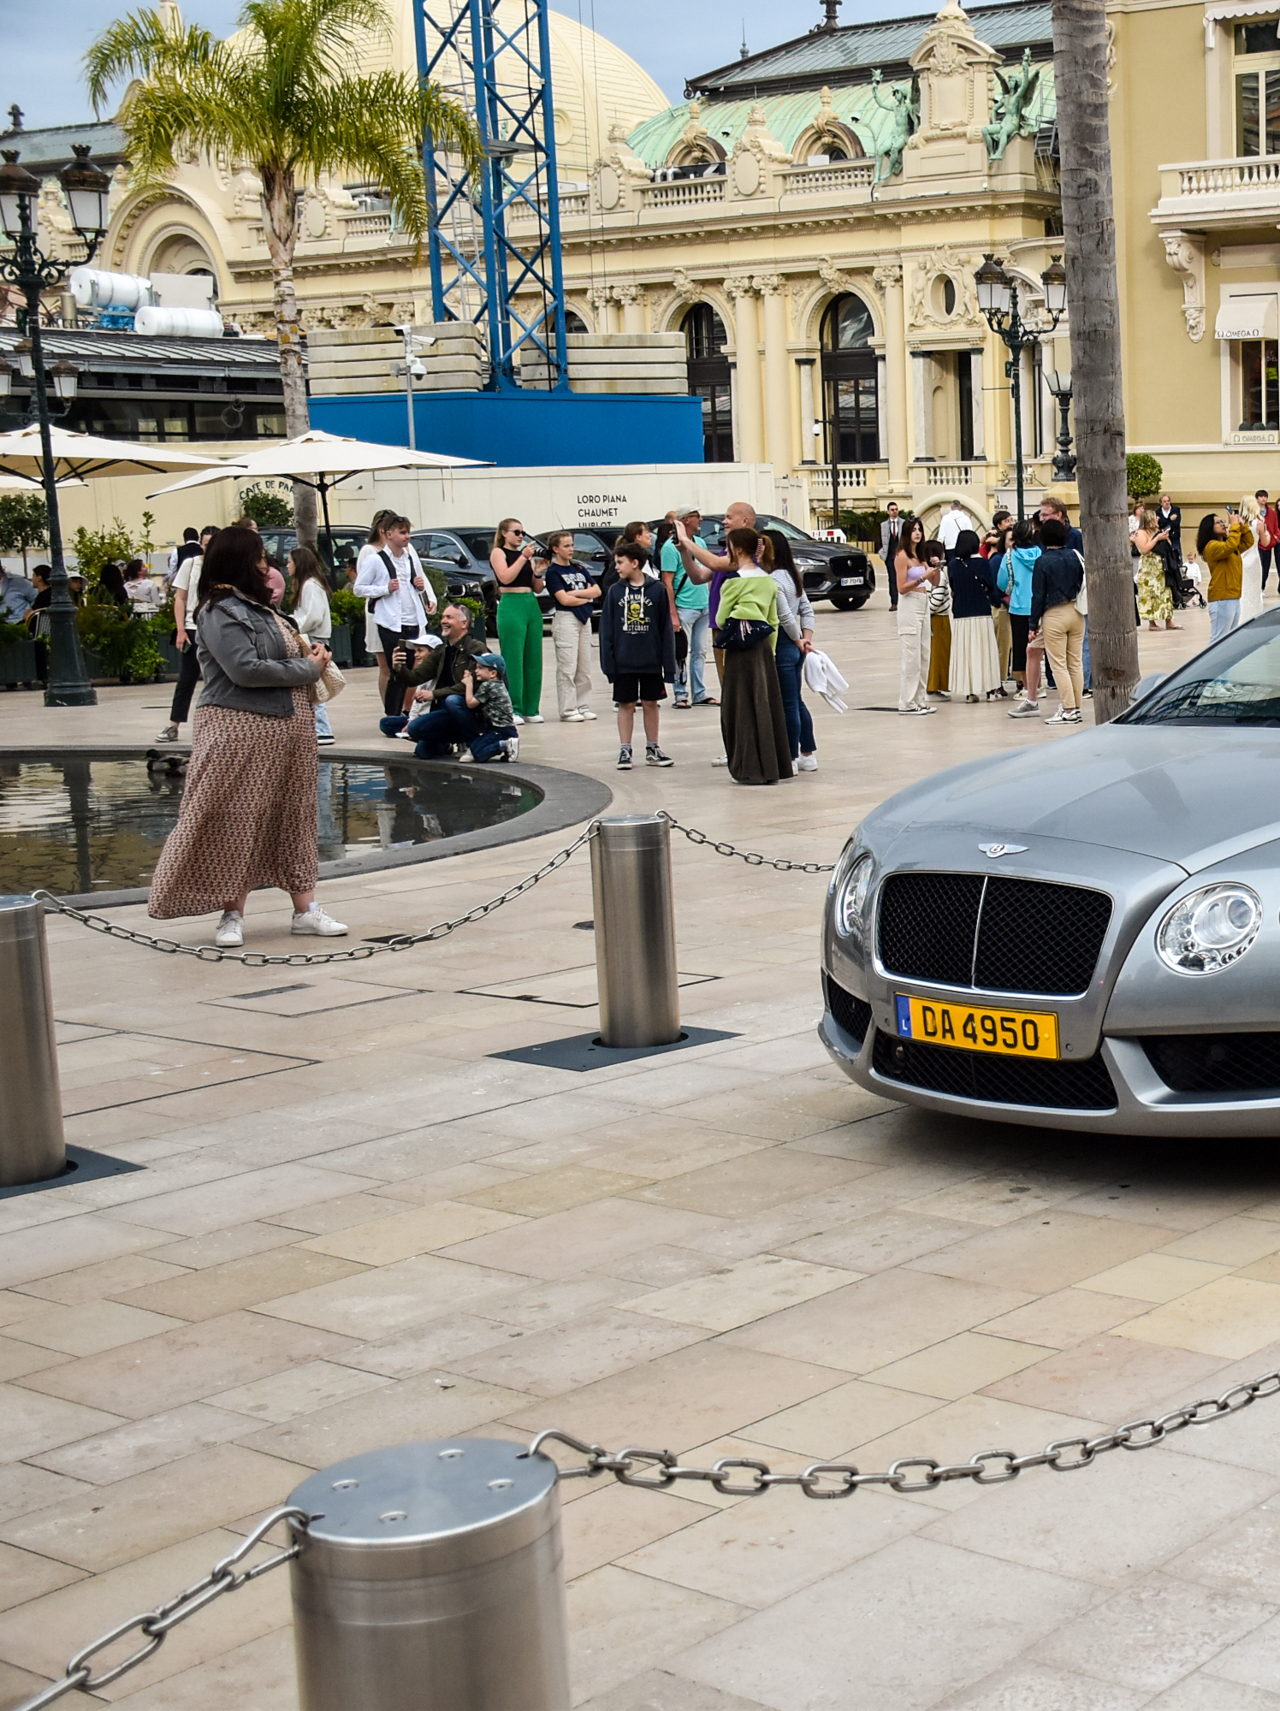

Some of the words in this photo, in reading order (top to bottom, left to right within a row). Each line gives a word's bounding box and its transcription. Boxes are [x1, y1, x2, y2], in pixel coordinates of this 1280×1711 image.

[1225, 330, 1251, 338] OMEGA
[265, 480, 275, 489] DE
[577, 494, 601, 504] LORO
[602, 494, 628, 504] PIANA
[578, 507, 619, 518] CHAUMET
[922, 1005, 955, 1040] DA
[962, 1012, 1040, 1051] 4950
